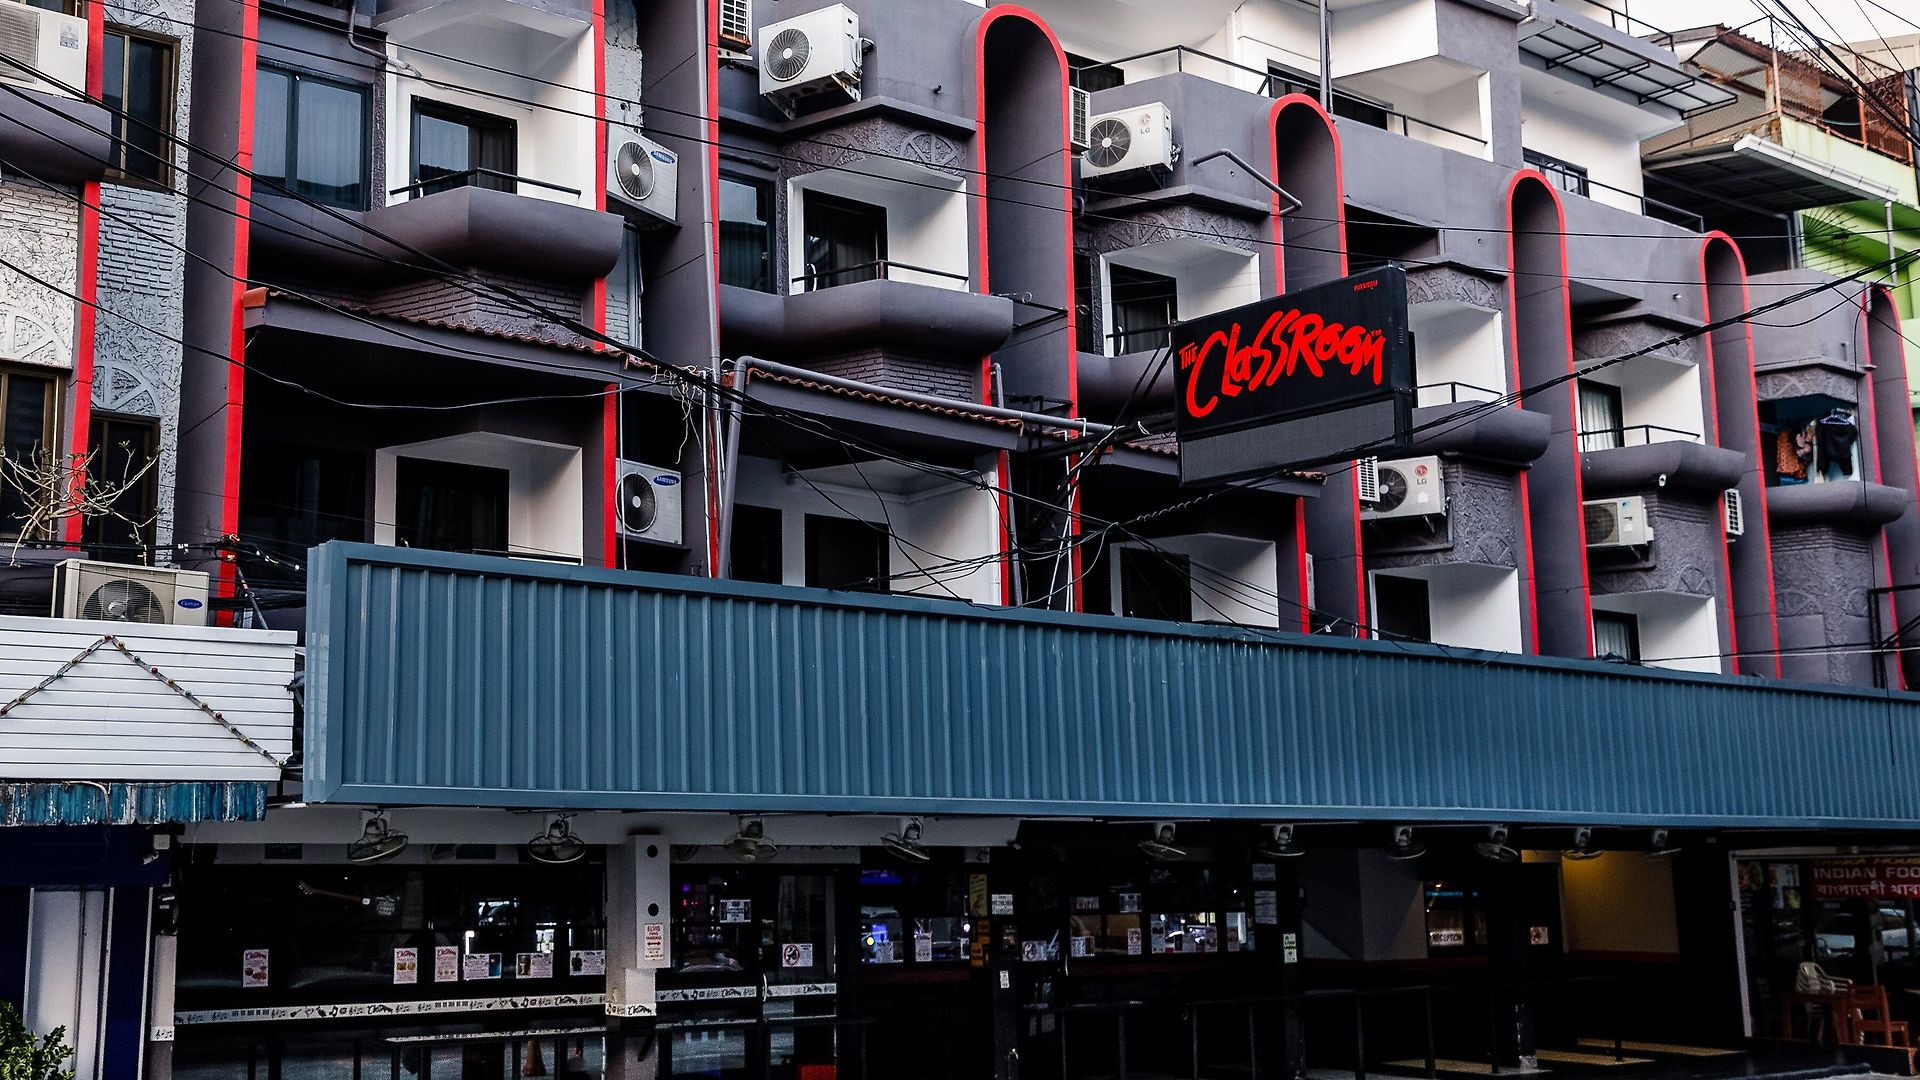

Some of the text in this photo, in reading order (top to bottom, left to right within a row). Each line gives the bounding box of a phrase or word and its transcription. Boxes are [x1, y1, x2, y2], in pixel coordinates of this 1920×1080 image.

[1179, 341, 1199, 370] THE
[656, 476, 677, 485] SAMSUNG
[1813, 867, 1877, 879] INDIAN
